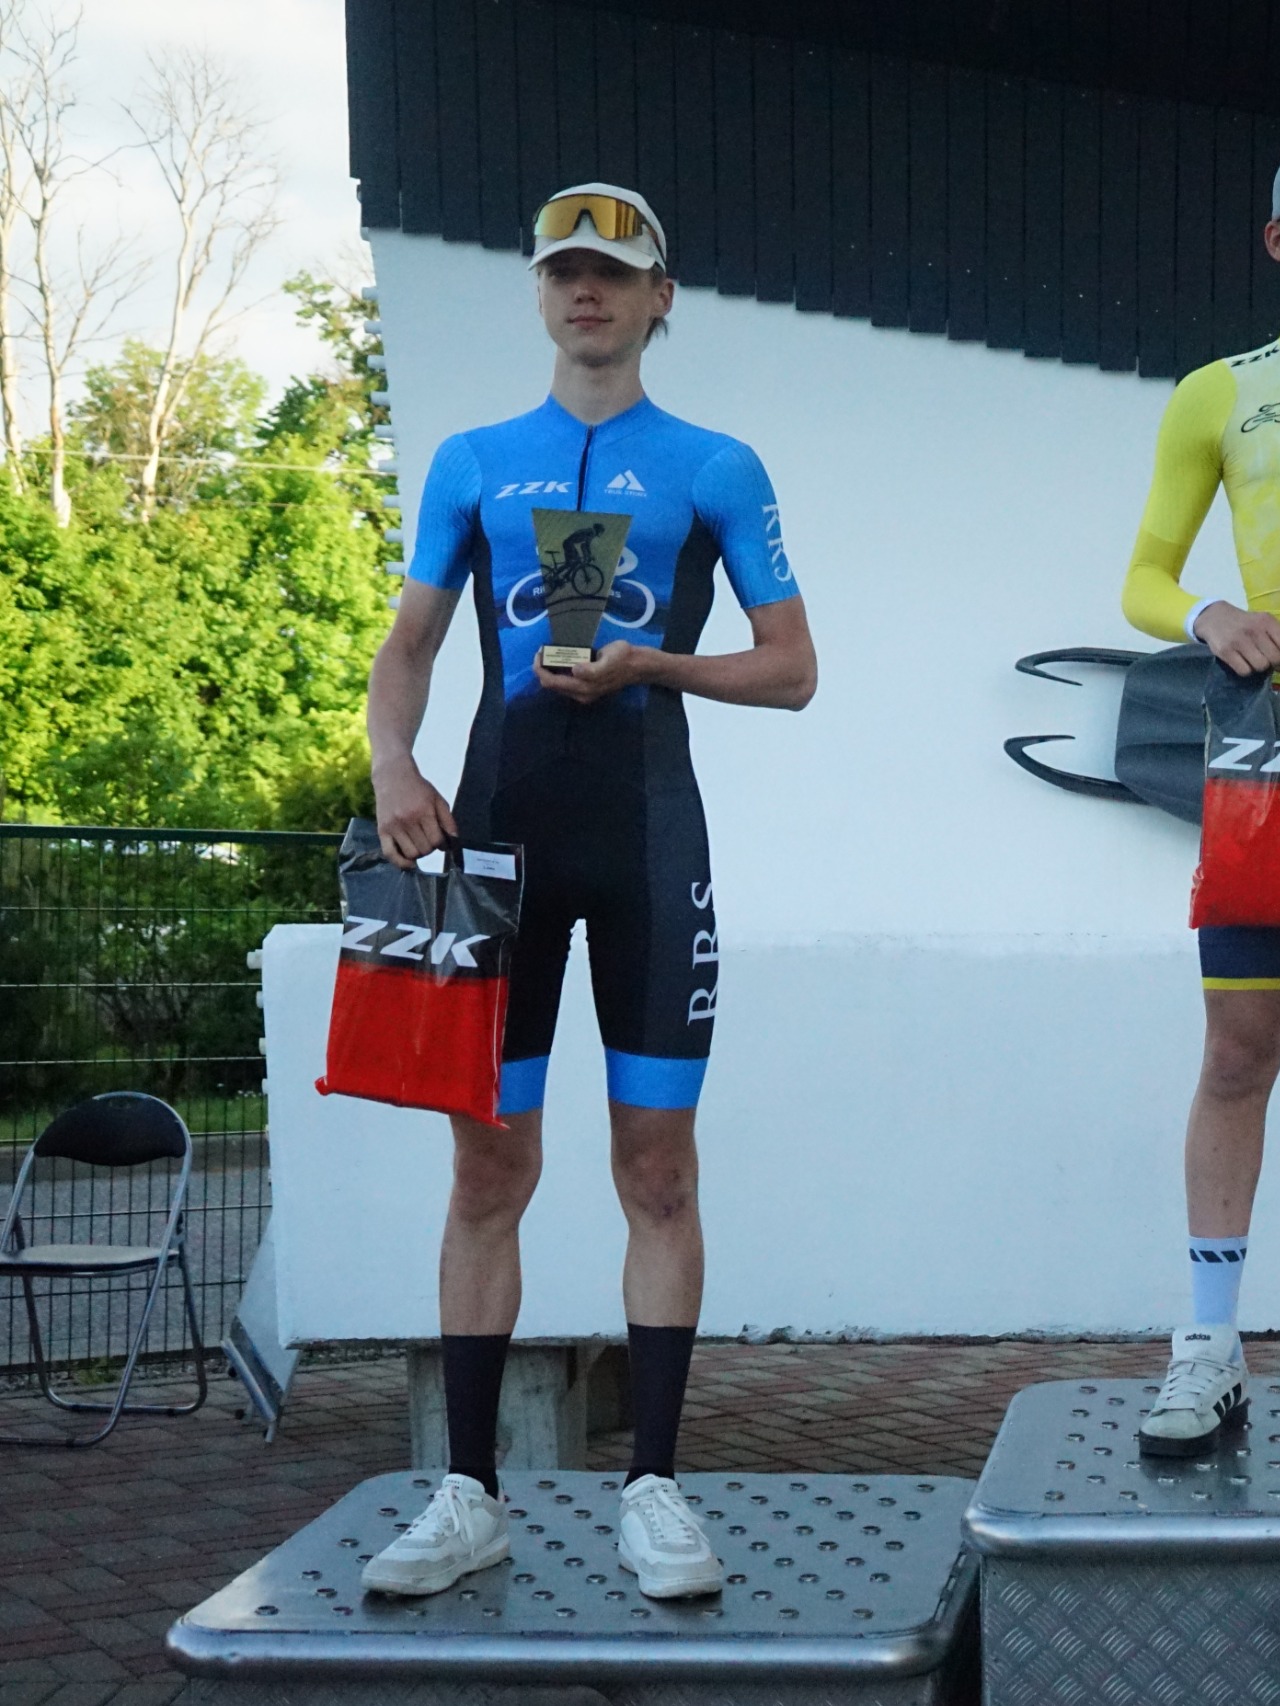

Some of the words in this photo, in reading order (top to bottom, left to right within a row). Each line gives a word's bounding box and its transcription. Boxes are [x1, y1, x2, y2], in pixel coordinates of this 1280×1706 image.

[1231, 344, 1279, 367] ZZK
[495, 481, 573, 499] ZZK
[341, 916, 491, 967] ZZK
[1185, 1333, 1211, 1341] adidas
